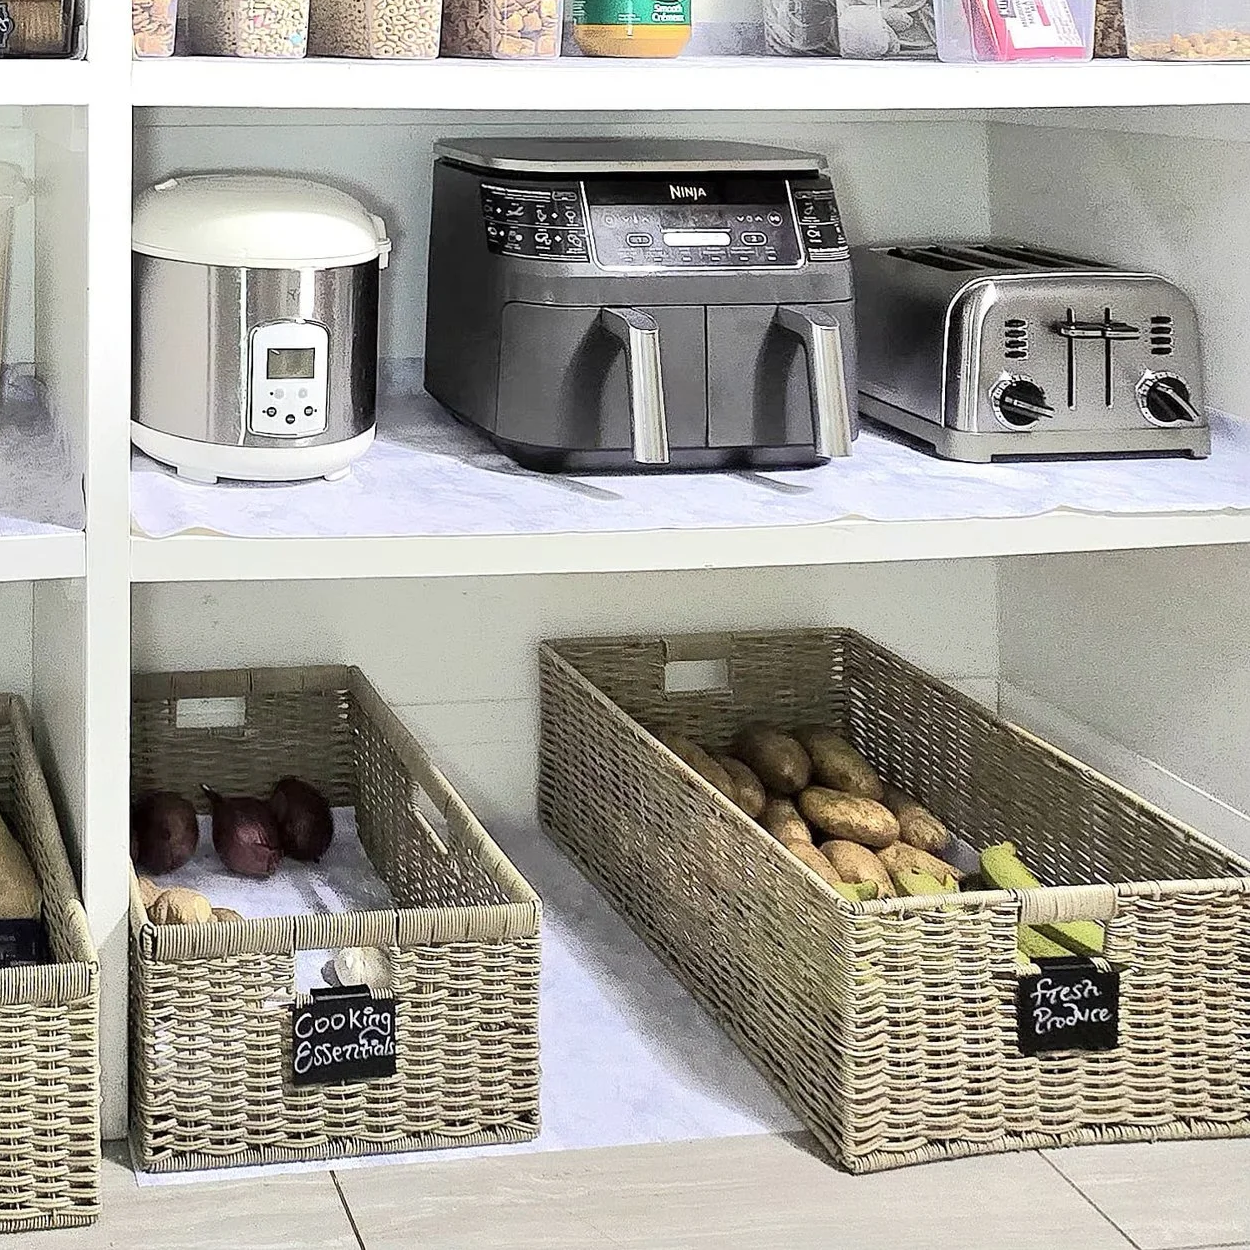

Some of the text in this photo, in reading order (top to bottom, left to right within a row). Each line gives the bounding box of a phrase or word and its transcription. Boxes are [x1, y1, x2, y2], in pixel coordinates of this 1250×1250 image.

[669, 184, 707, 201] NINJA
[295, 1007, 392, 1042] Cooking
[1033, 1002, 1112, 1034] Produce
[293, 1038, 396, 1074] Essentials
